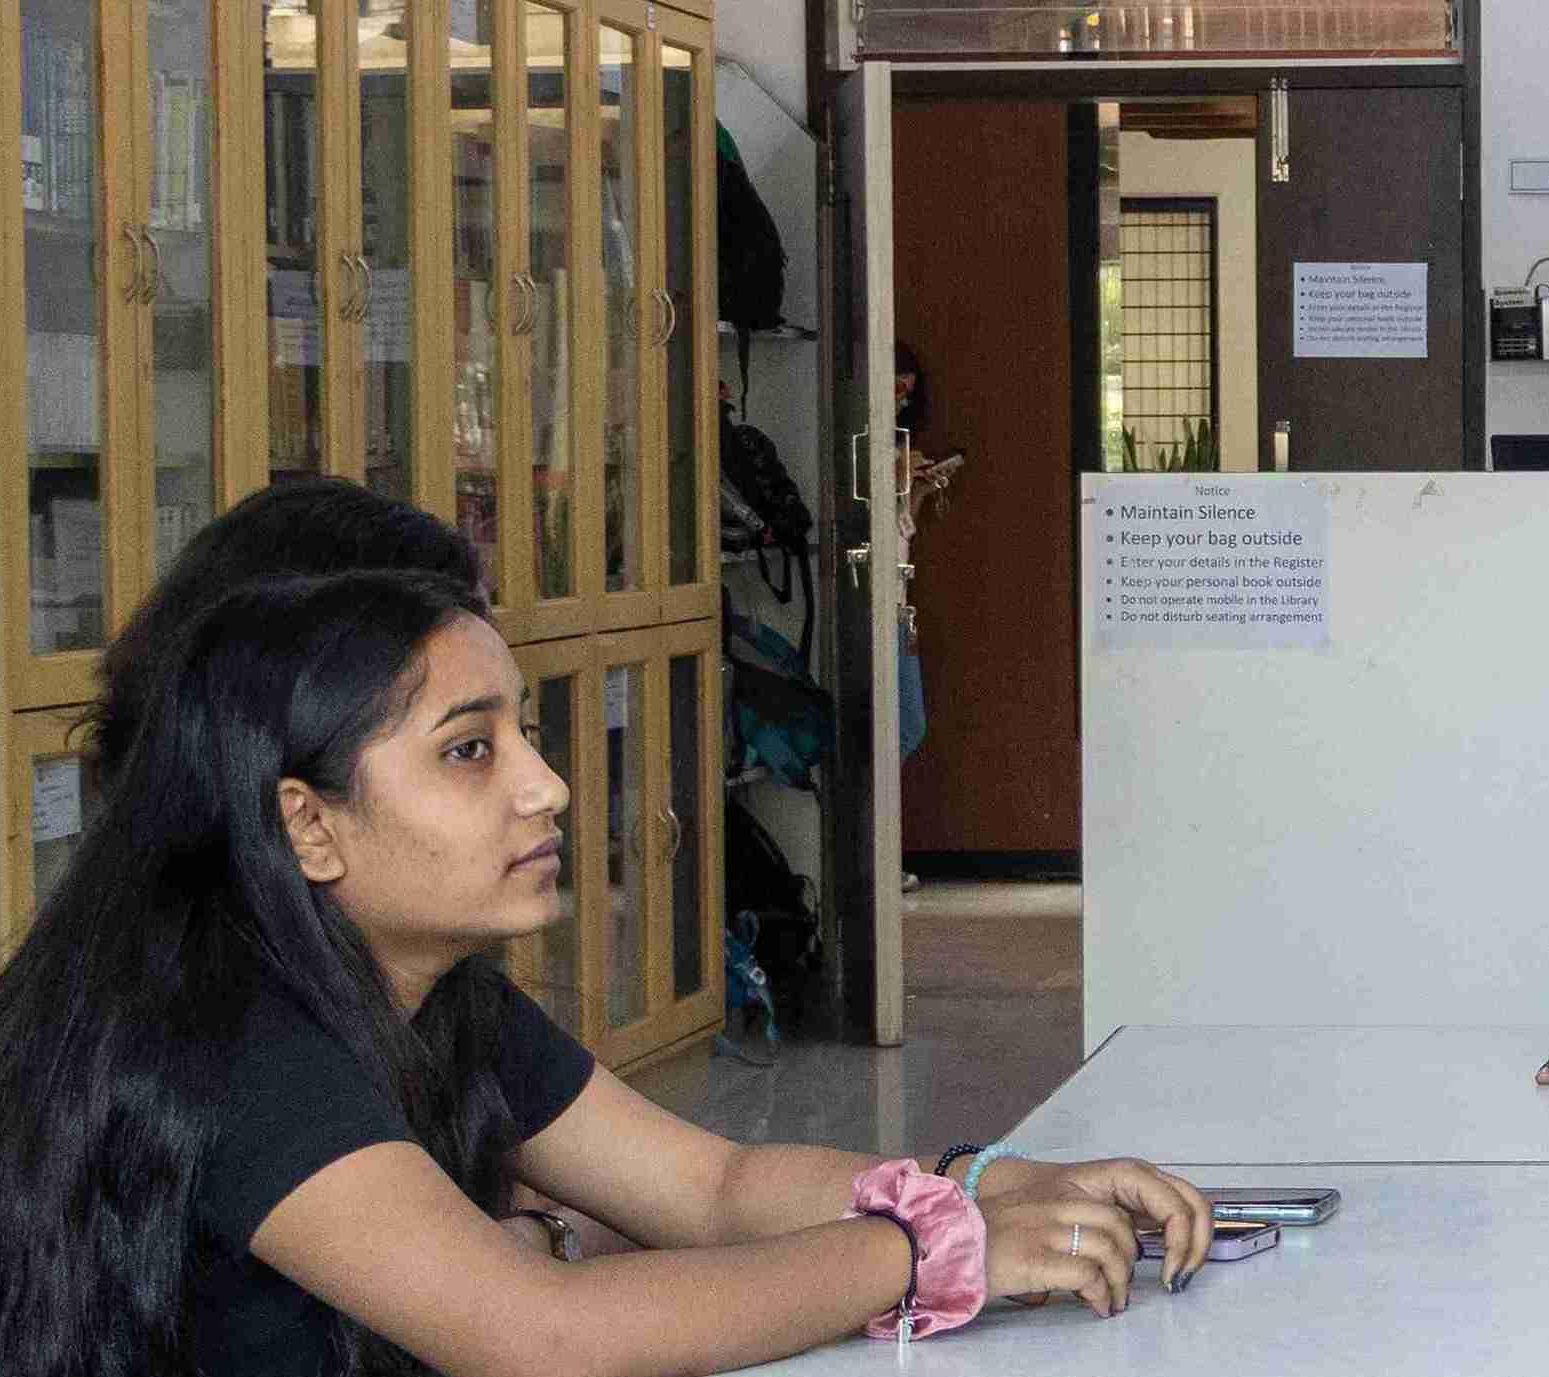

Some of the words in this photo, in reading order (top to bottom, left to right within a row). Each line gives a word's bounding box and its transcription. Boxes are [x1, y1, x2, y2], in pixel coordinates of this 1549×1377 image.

[1196, 485, 1231, 497] Notice
[1120, 505, 1194, 520] Maintain
[1198, 505, 1256, 520] Silence
[1120, 531, 1162, 547] Keep
[1166, 534, 1203, 547] your
[1208, 531, 1238, 549] bag
[1242, 531, 1303, 546] outside
[1120, 557, 1153, 569] Enter
[1158, 559, 1185, 571] your
[1190, 556, 1231, 569] details
[1234, 557, 1246, 569] in
[1249, 557, 1270, 569] the
[1274, 556, 1324, 571] Register
[1120, 576, 1151, 590] Keep
[1155, 578, 1183, 590] your
[1186, 576, 1239, 590] personal
[1243, 575, 1272, 588] book
[1276, 575, 1322, 588] outside
[1120, 595, 1136, 605] Do
[1138, 594, 1157, 606] not
[1160, 595, 1203, 607] operate
[1206, 594, 1244, 606] mobile
[1247, 594, 1257, 606] in
[1260, 594, 1278, 606] the
[1281, 594, 1320, 608] Library
[1120, 612, 1136, 623] Do
[1139, 612, 1160, 623] not
[1163, 611, 1202, 623] disturb
[1205, 611, 1247, 625] seating
[1250, 612, 1324, 625] arrangement
